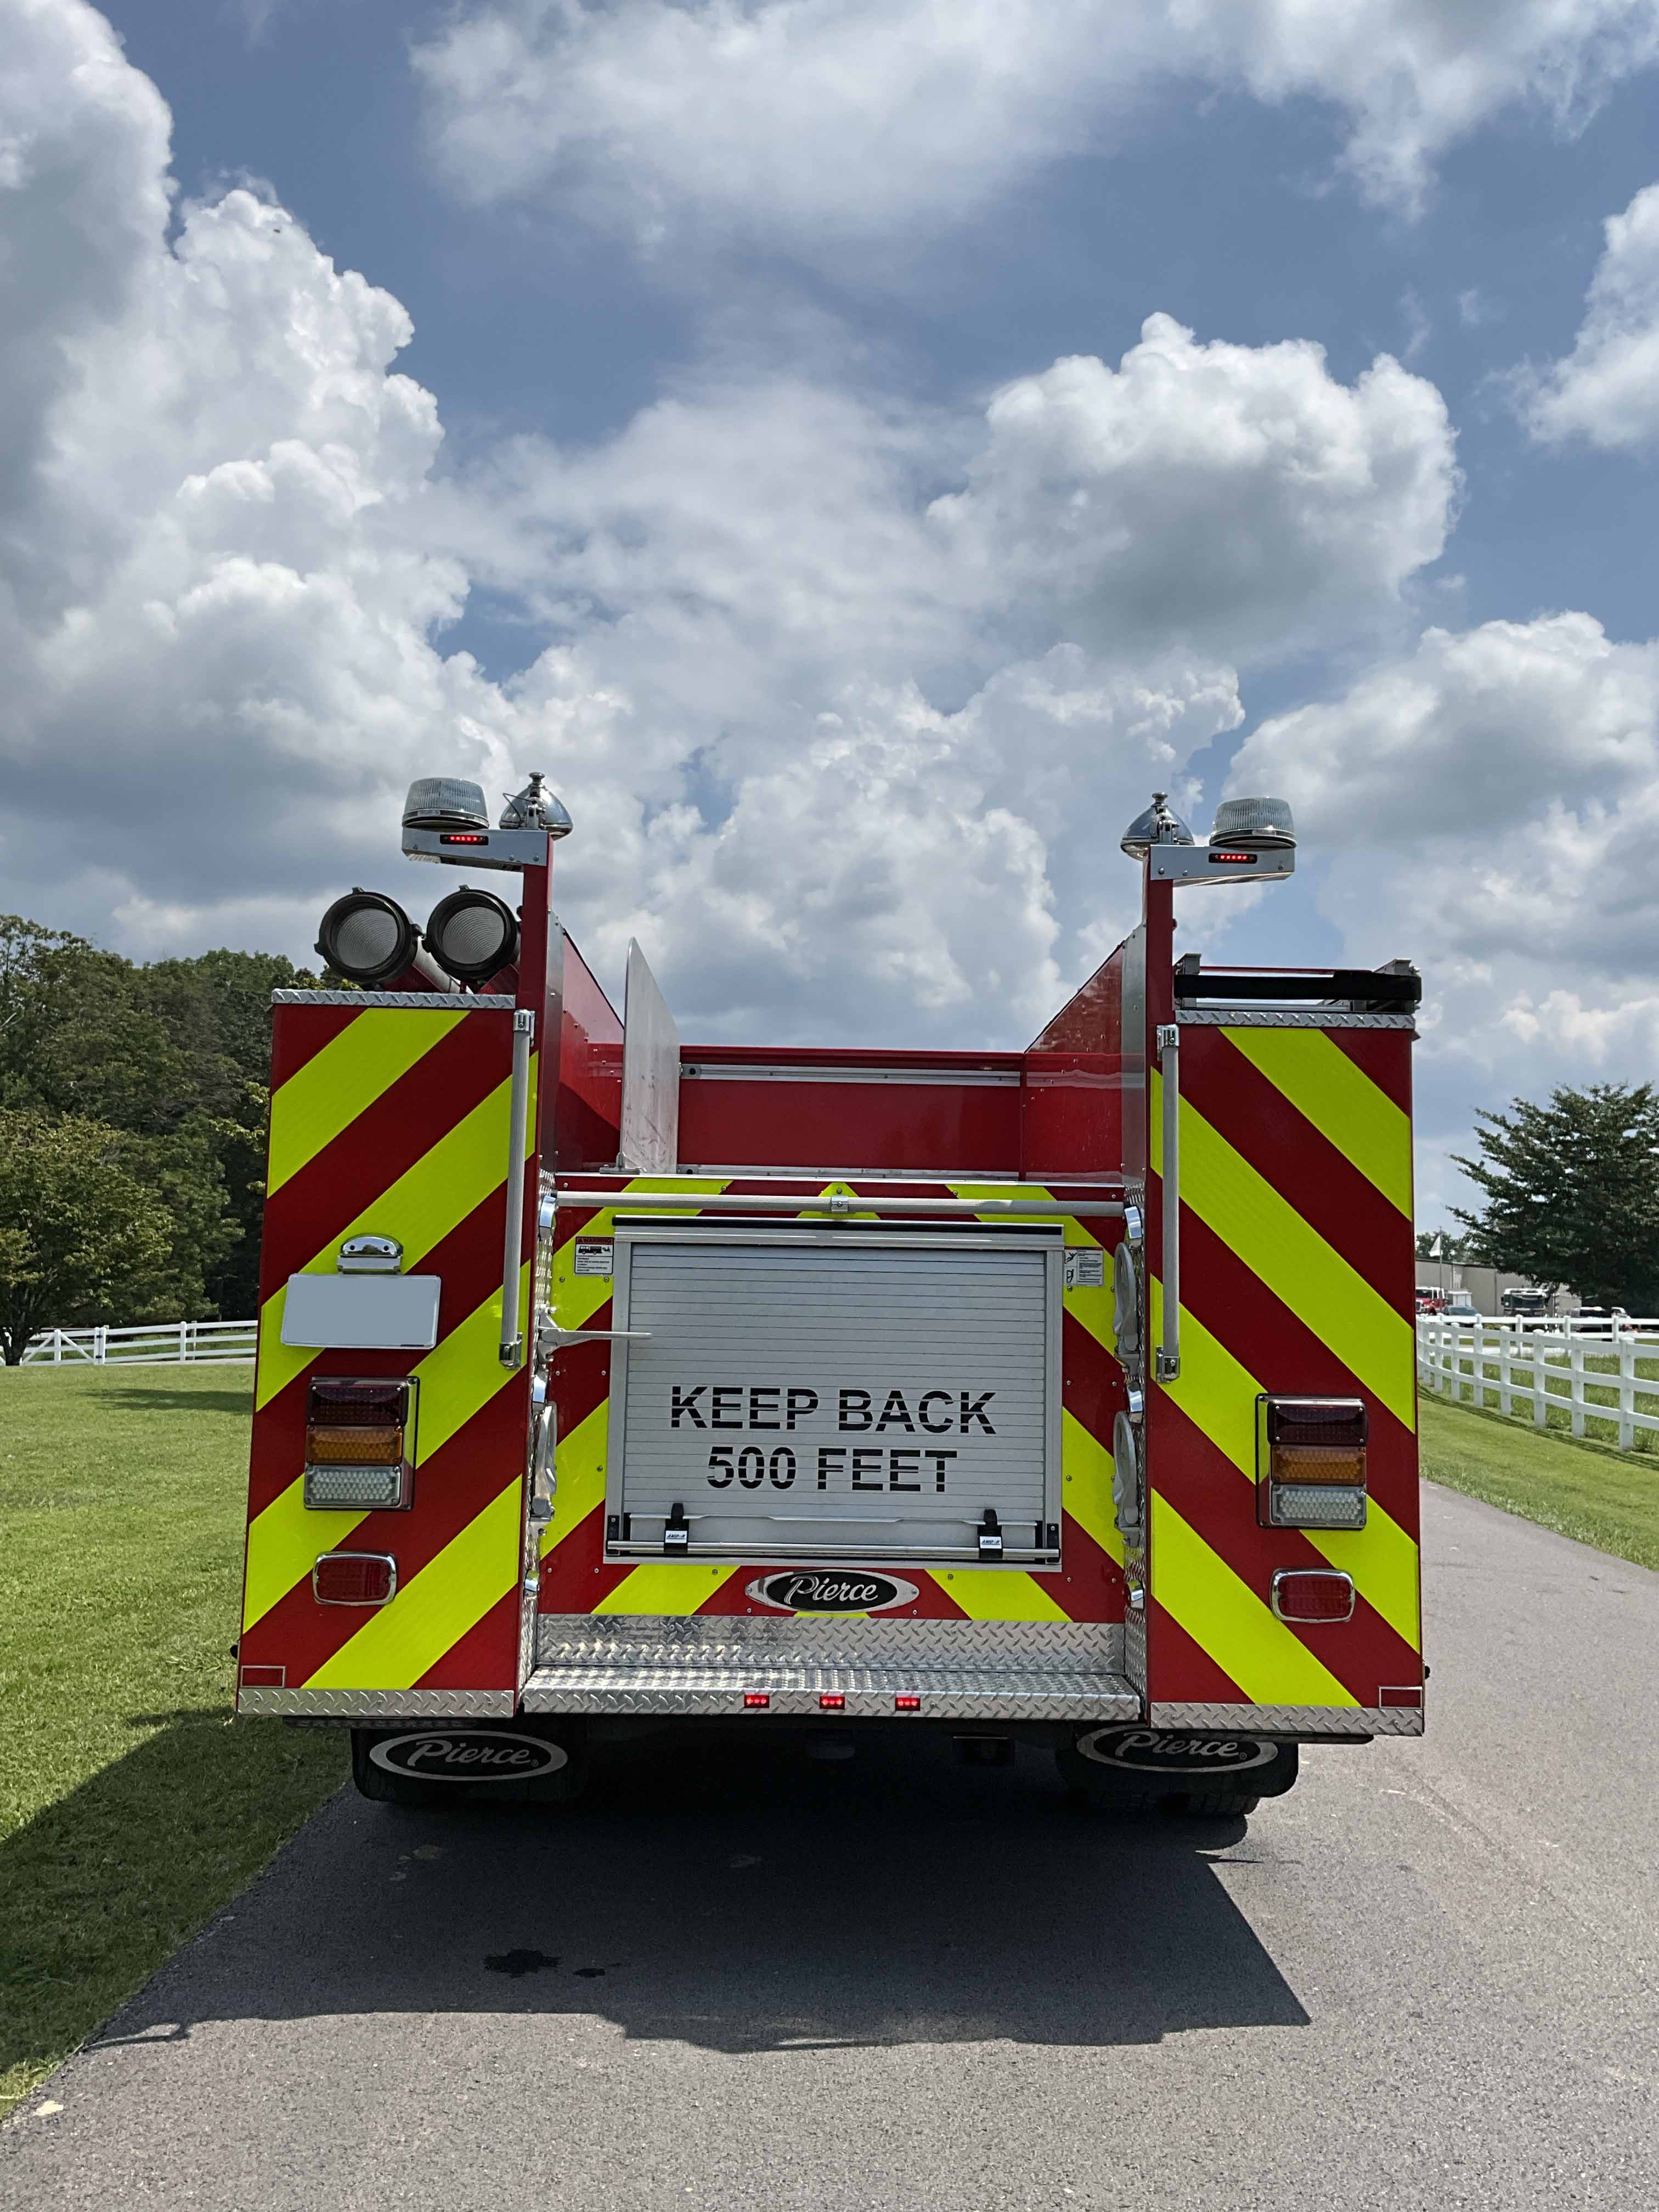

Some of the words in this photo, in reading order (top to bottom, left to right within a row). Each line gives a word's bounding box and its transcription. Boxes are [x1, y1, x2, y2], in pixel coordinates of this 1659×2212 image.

[671, 1386, 819, 1430] KEEP
[838, 1389, 996, 1435] BACK
[706, 1446, 797, 1489] 500
[817, 1448, 957, 1492] FEET
[784, 1575, 878, 1605] Pierce
[407, 1739, 531, 1767] Pierce
[1115, 1730, 1239, 1756] Pierce
